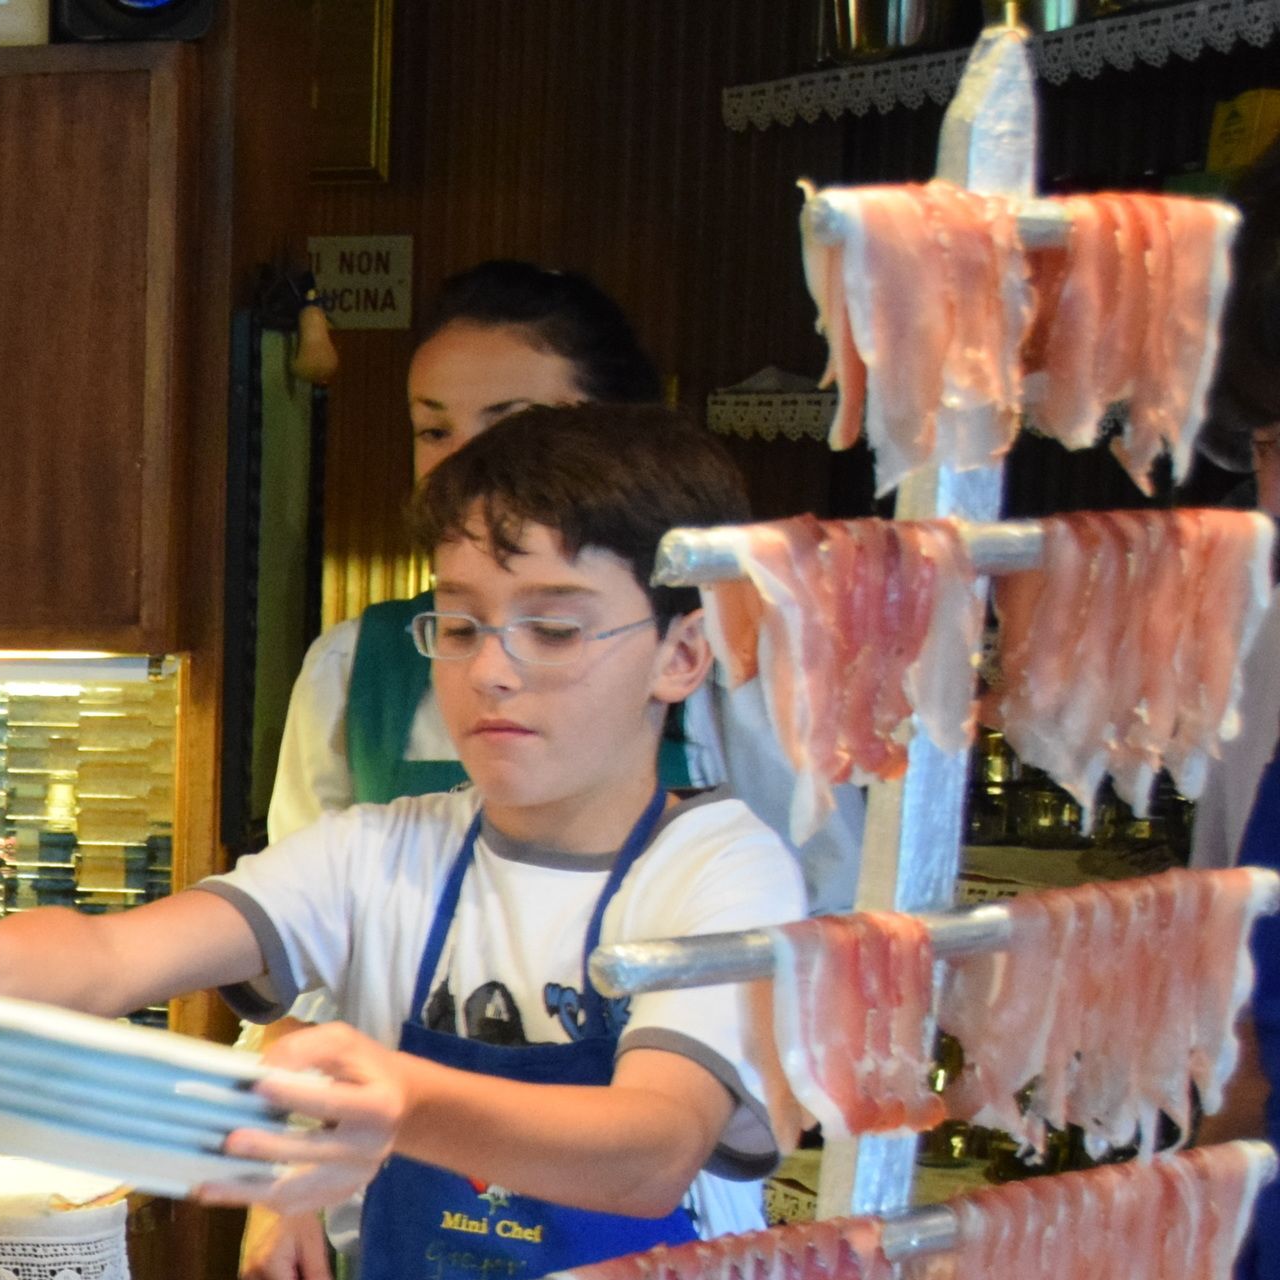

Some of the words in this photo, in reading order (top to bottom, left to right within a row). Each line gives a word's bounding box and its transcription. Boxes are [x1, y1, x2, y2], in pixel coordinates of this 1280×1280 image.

[339, 250, 391, 275] NON
[440, 1210, 488, 1234] Mini
[495, 1219, 543, 1243] Chef
